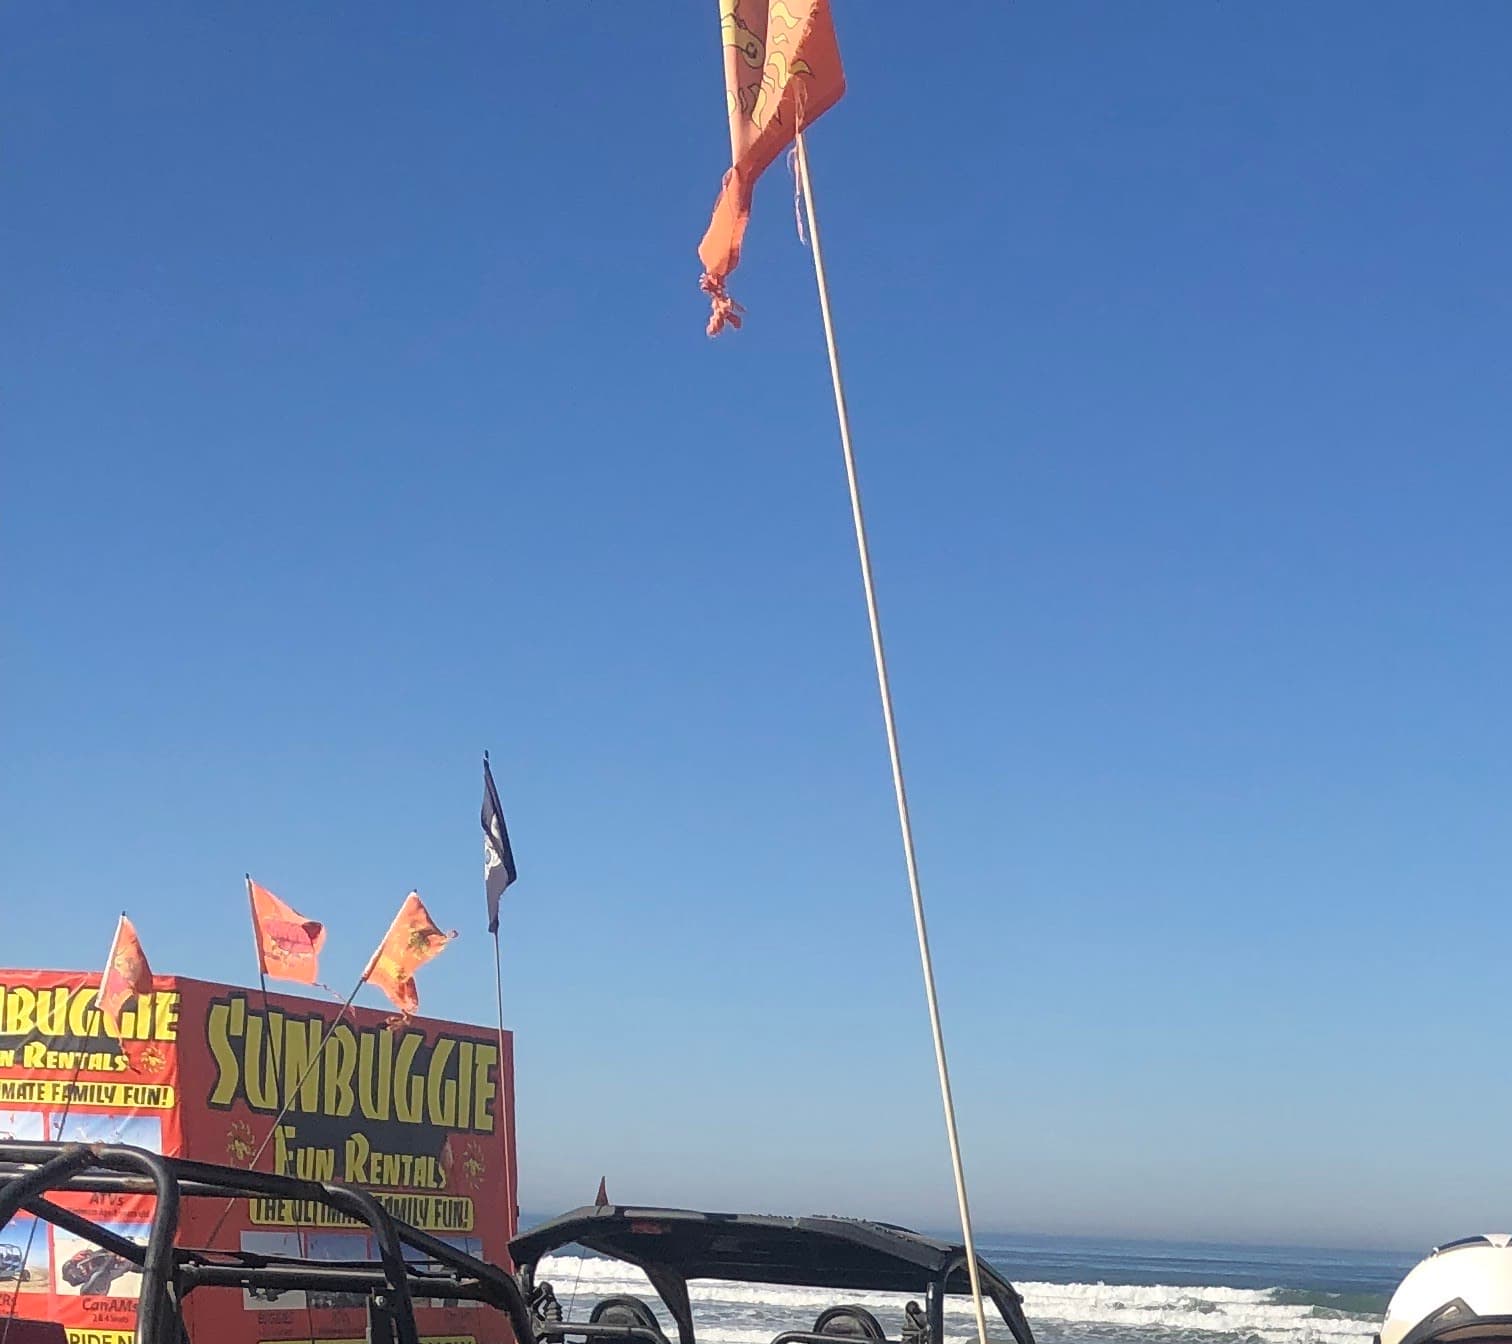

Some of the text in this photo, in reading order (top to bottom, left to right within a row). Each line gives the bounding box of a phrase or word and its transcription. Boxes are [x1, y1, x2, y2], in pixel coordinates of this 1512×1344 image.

[0, 985, 180, 1041] BUGGIE
[207, 997, 498, 1132] SUNBUGGIE
[51, 1083, 116, 1104] FAMILY
[123, 1086, 170, 1106] FUN!
[434, 1198, 470, 1229] FUN!
